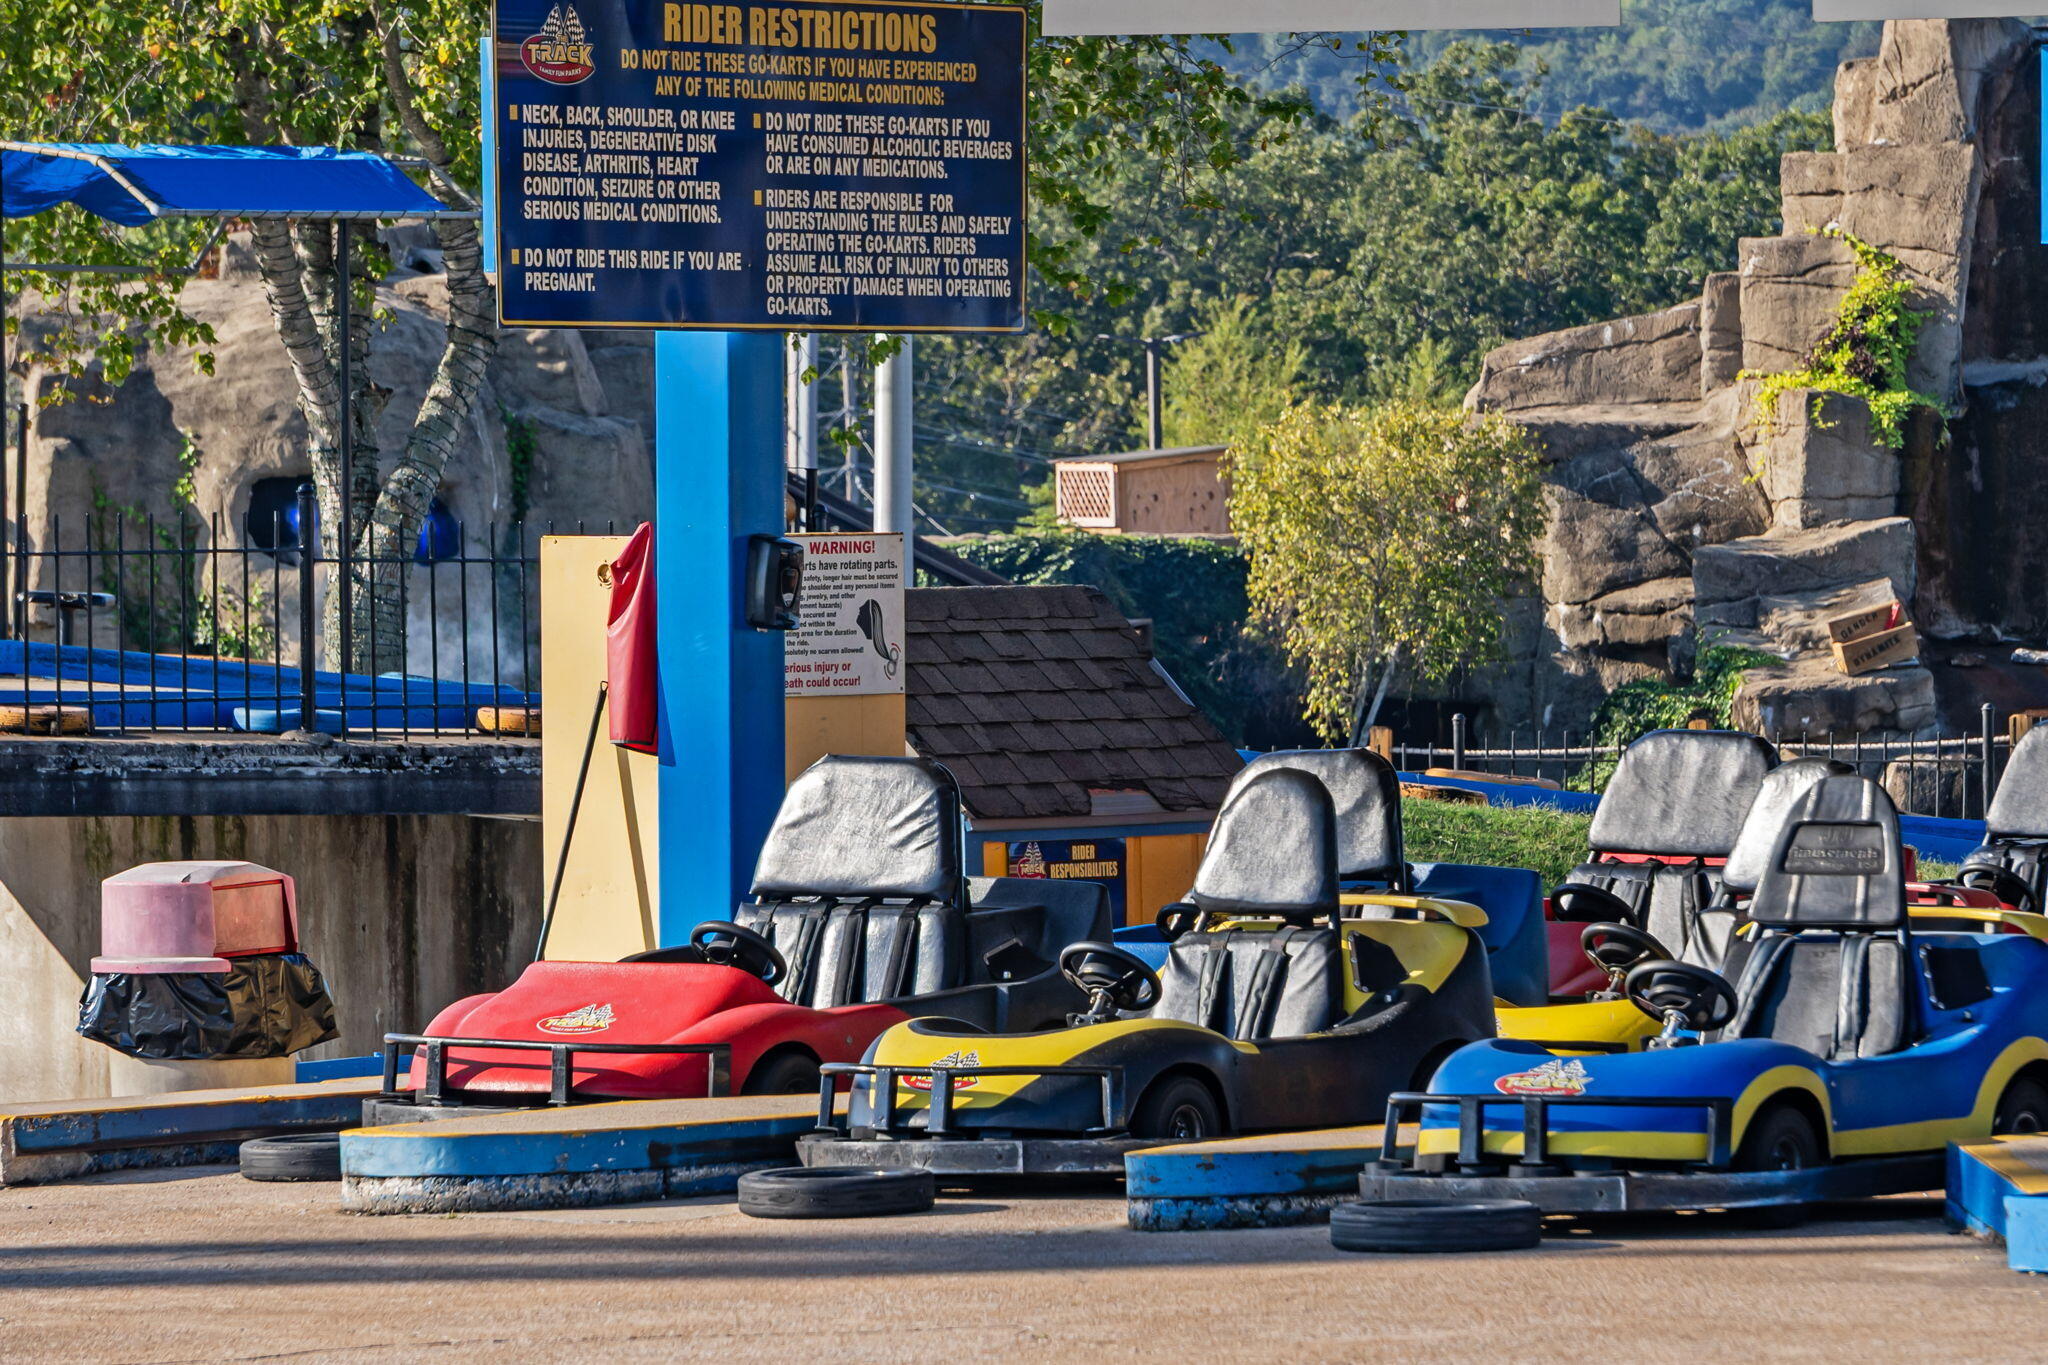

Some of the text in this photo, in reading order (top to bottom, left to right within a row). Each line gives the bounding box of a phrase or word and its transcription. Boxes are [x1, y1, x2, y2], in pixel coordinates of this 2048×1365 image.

[664, 3, 936, 53] RIDER RESTRICTIONS
[528, 44, 593, 67] TRACK
[621, 49, 977, 82] DO NOT RIDE THESE GO-KARTS IF YOU HAVE EXPERIENCED
[655, 75, 945, 106] ANY OF THE FOLLOWING MEDICAL CONDITIONS:
[523, 104, 735, 132] NECK, BACK, SHOULDER, OR KNEE
[766, 112, 990, 138] DO NOT RIDE THESE GO-KARTS IF YOU
[523, 129, 716, 153] INJURIES, DEGENERATIVE DISK
[766, 134, 1012, 160] HAVE CONSUMED ALCOHOLIC BEVERAGES
[523, 153, 698, 178] DISEASE, ARTHRITIS, HEART
[766, 155, 947, 179] OR ARE ON ANY MEDICATIONS.
[524, 177, 720, 201] CONDITION, SEIZURE OR OTHER
[766, 189, 953, 212] RIDERS ARE RESPONSIBLE FOR
[524, 201, 721, 223] SERIOUS MEDICAL CONDITIONS.
[766, 211, 1011, 235] UNDERSTANDING THE RULES AND SAFELY
[766, 233, 976, 254] OPERATING THE GO-KARTS. RIDERS
[525, 248, 741, 270] DO NOT RIDE THIS RIDE IF YOU ARE
[766, 254, 1008, 276] ASSUME ALL RISK OF INJURY TO OTHERS
[525, 272, 595, 291] PREGNANT.
[766, 275, 1011, 297] OR PROPERTY DAMAGE WHEN OPERATING
[767, 297, 832, 316] GO-KARTS.
[809, 541, 875, 554] WARNING!
[819, 560, 837, 570] have
[840, 560, 871, 572] rotating
[874, 559, 897, 571] parts.
[807, 593, 828, 601] jewelry,
[856, 583, 878, 591] personal
[1853, 633, 1900, 667] DYNAMITE
[785, 662, 851, 674] erious injury or
[785, 676, 860, 688] eath could occur!
[1072, 845, 1095, 860] RIDER
[1020, 863, 1046, 876] TRACK
[1050, 861, 1118, 878] RESPONSIBILITIES
